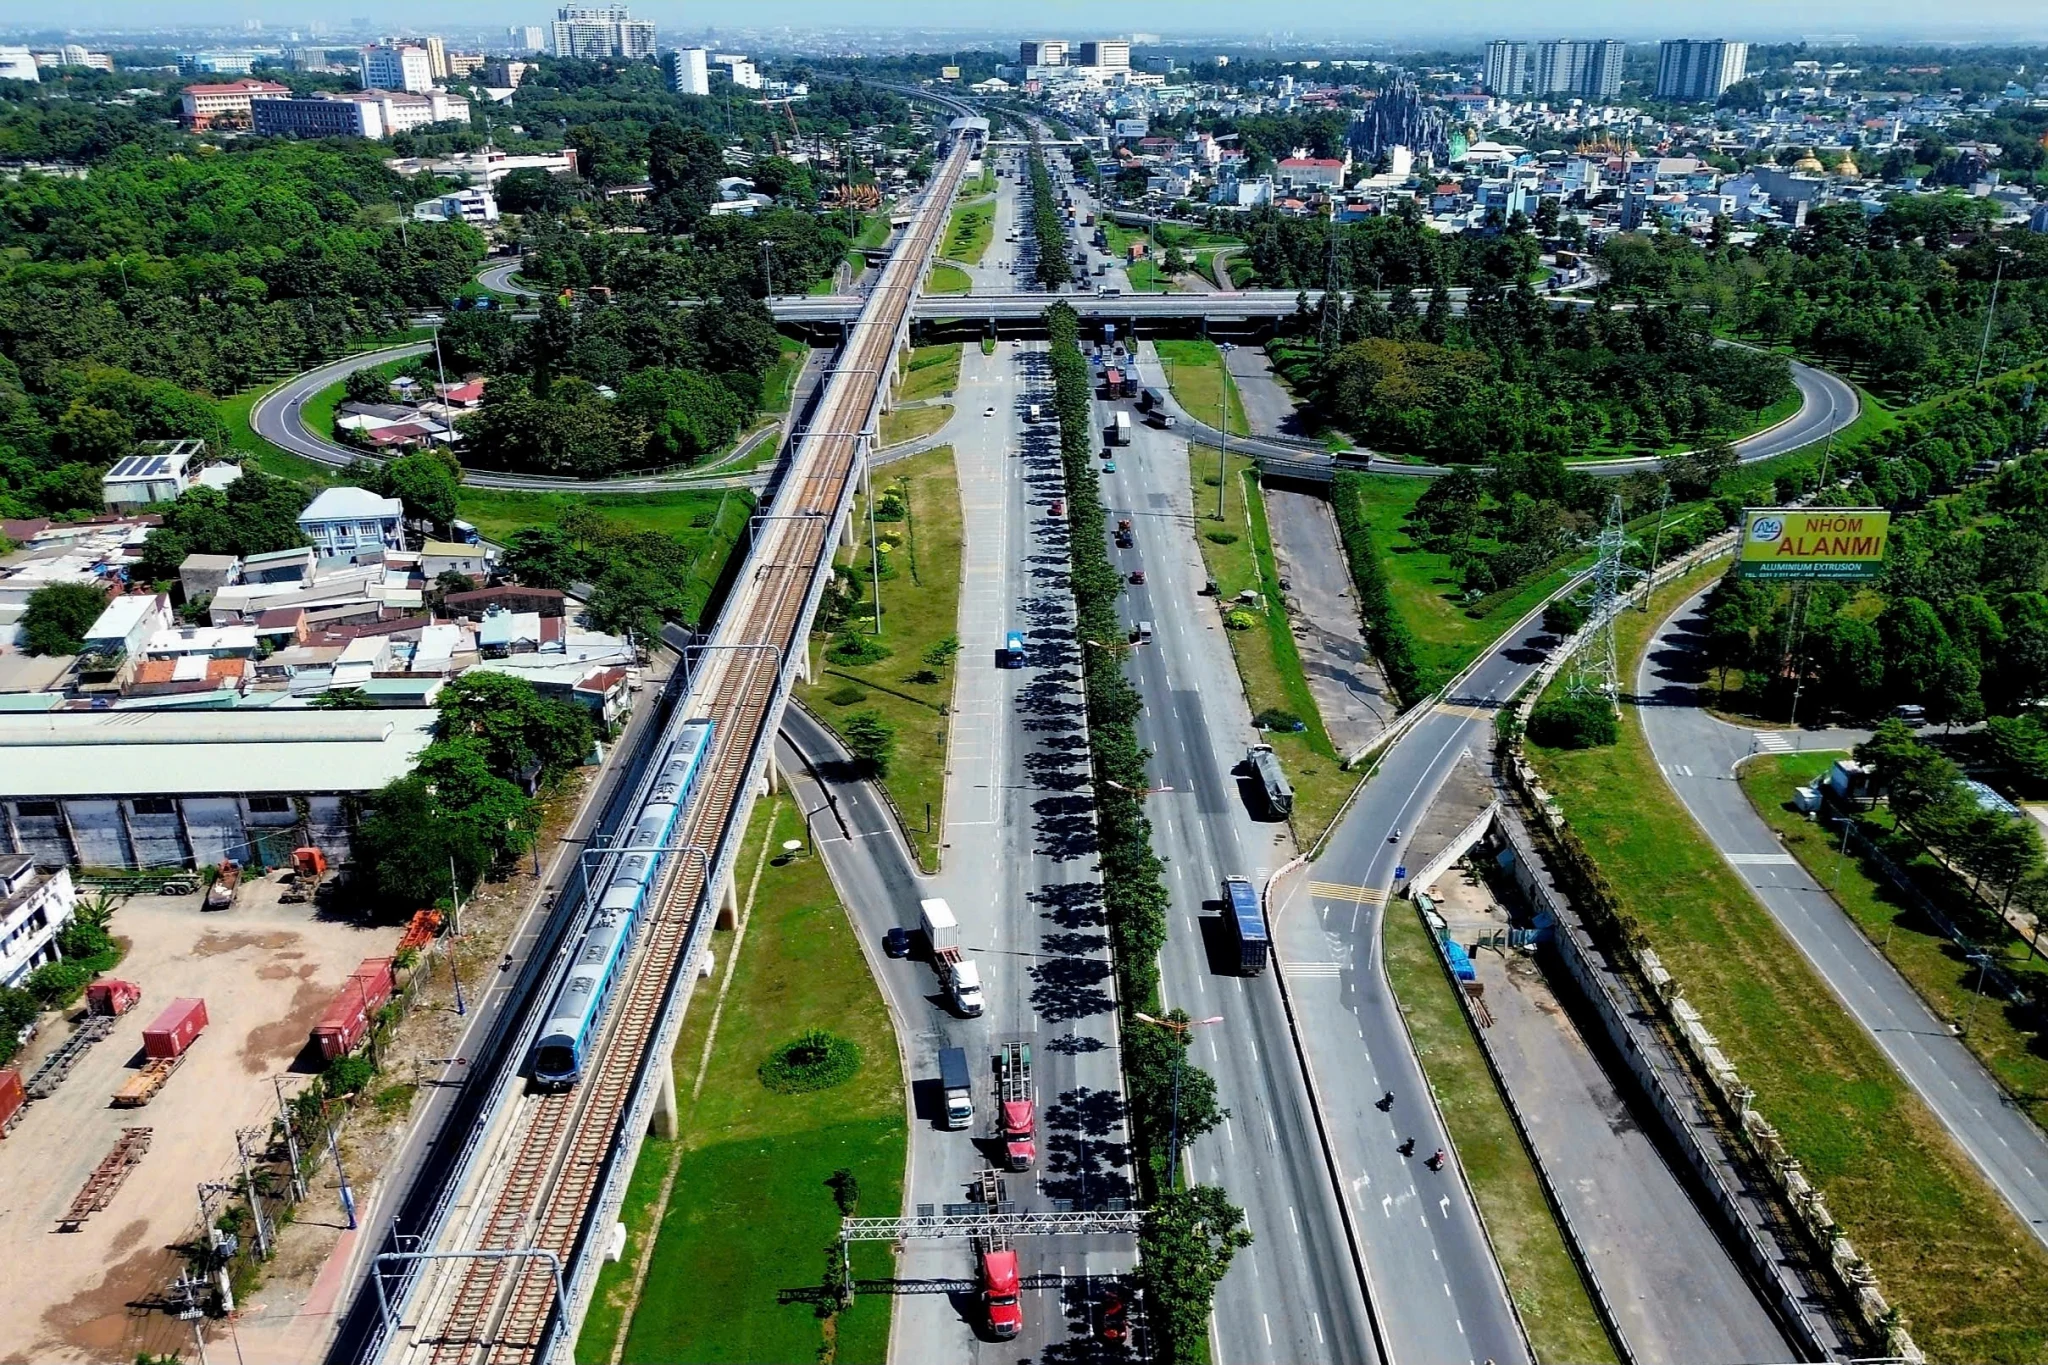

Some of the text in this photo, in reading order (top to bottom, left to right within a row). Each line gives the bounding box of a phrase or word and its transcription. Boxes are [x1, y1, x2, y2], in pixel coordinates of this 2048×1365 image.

[1806, 515, 1863, 532] NHÔM
[1776, 537, 1880, 556] ALANMI
[1760, 563, 1862, 571] ALUMINIUM EXTRUSION
